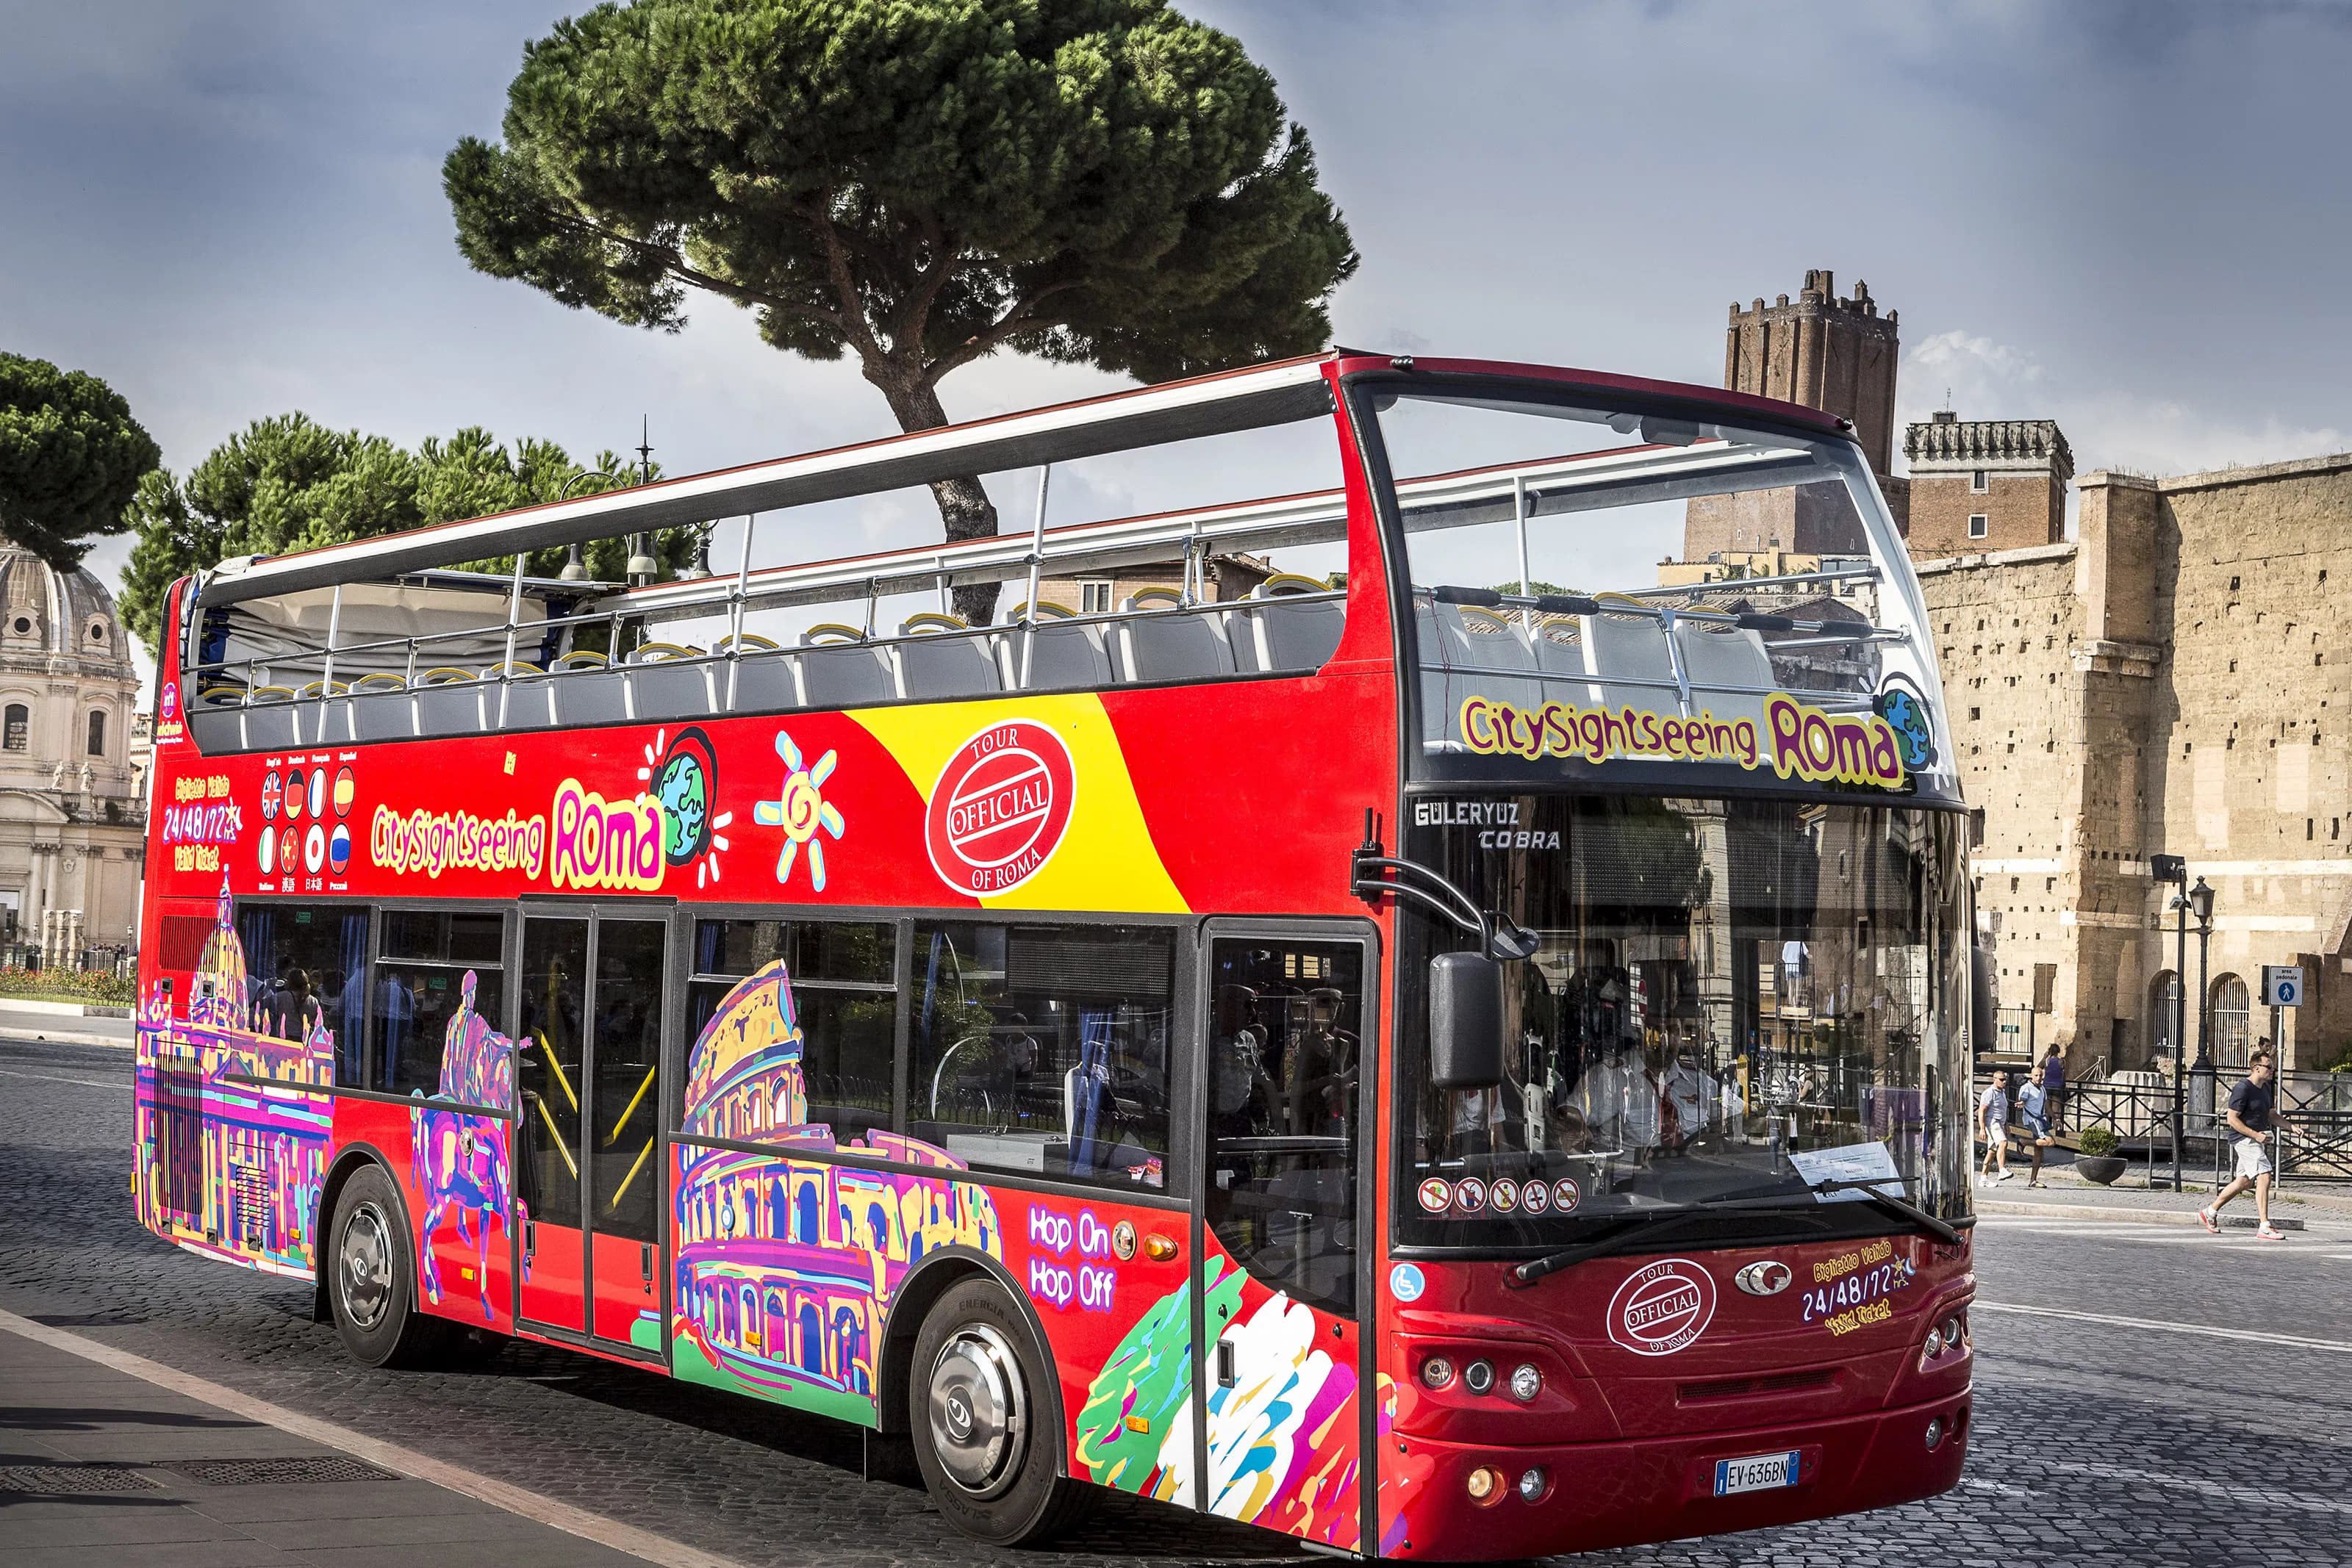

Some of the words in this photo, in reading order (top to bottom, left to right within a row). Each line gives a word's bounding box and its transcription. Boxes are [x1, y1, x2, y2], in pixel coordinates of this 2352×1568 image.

[970, 727, 1019, 760] TOUR
[1764, 691, 1904, 788] Roma
[162, 805, 226, 842] 24/48/72
[950, 780, 1047, 835] OFFICIAL
[1415, 802, 1519, 827] GÜLERYÜZ
[551, 777, 666, 891] Roma
[1478, 830, 1560, 850] COBRA
[174, 845, 195, 872] Valid
[971, 868, 992, 890] OF
[994, 847, 1042, 888] ROMA
[306, 877, 323, 891] 日本語
[1030, 1206, 1072, 1253] Hop
[1078, 1212, 1108, 1255] On
[1638, 1264, 1675, 1284] TOUR
[1813, 1253, 1860, 1283] Biglietto
[1861, 1240, 1892, 1265] Valido
[1030, 1259, 1072, 1306] Hop
[1079, 1265, 1114, 1308] Off
[1803, 1265, 1891, 1321] 24/48/72
[1627, 1291, 1698, 1326] OFFICIAL
[1825, 1309, 1860, 1337] Valid
[1856, 1298, 1892, 1323] Ticket
[1649, 1342, 1666, 1352] OF
[1666, 1327, 1696, 1349] ROMA
[1748, 1459, 1789, 1485] 636BN
